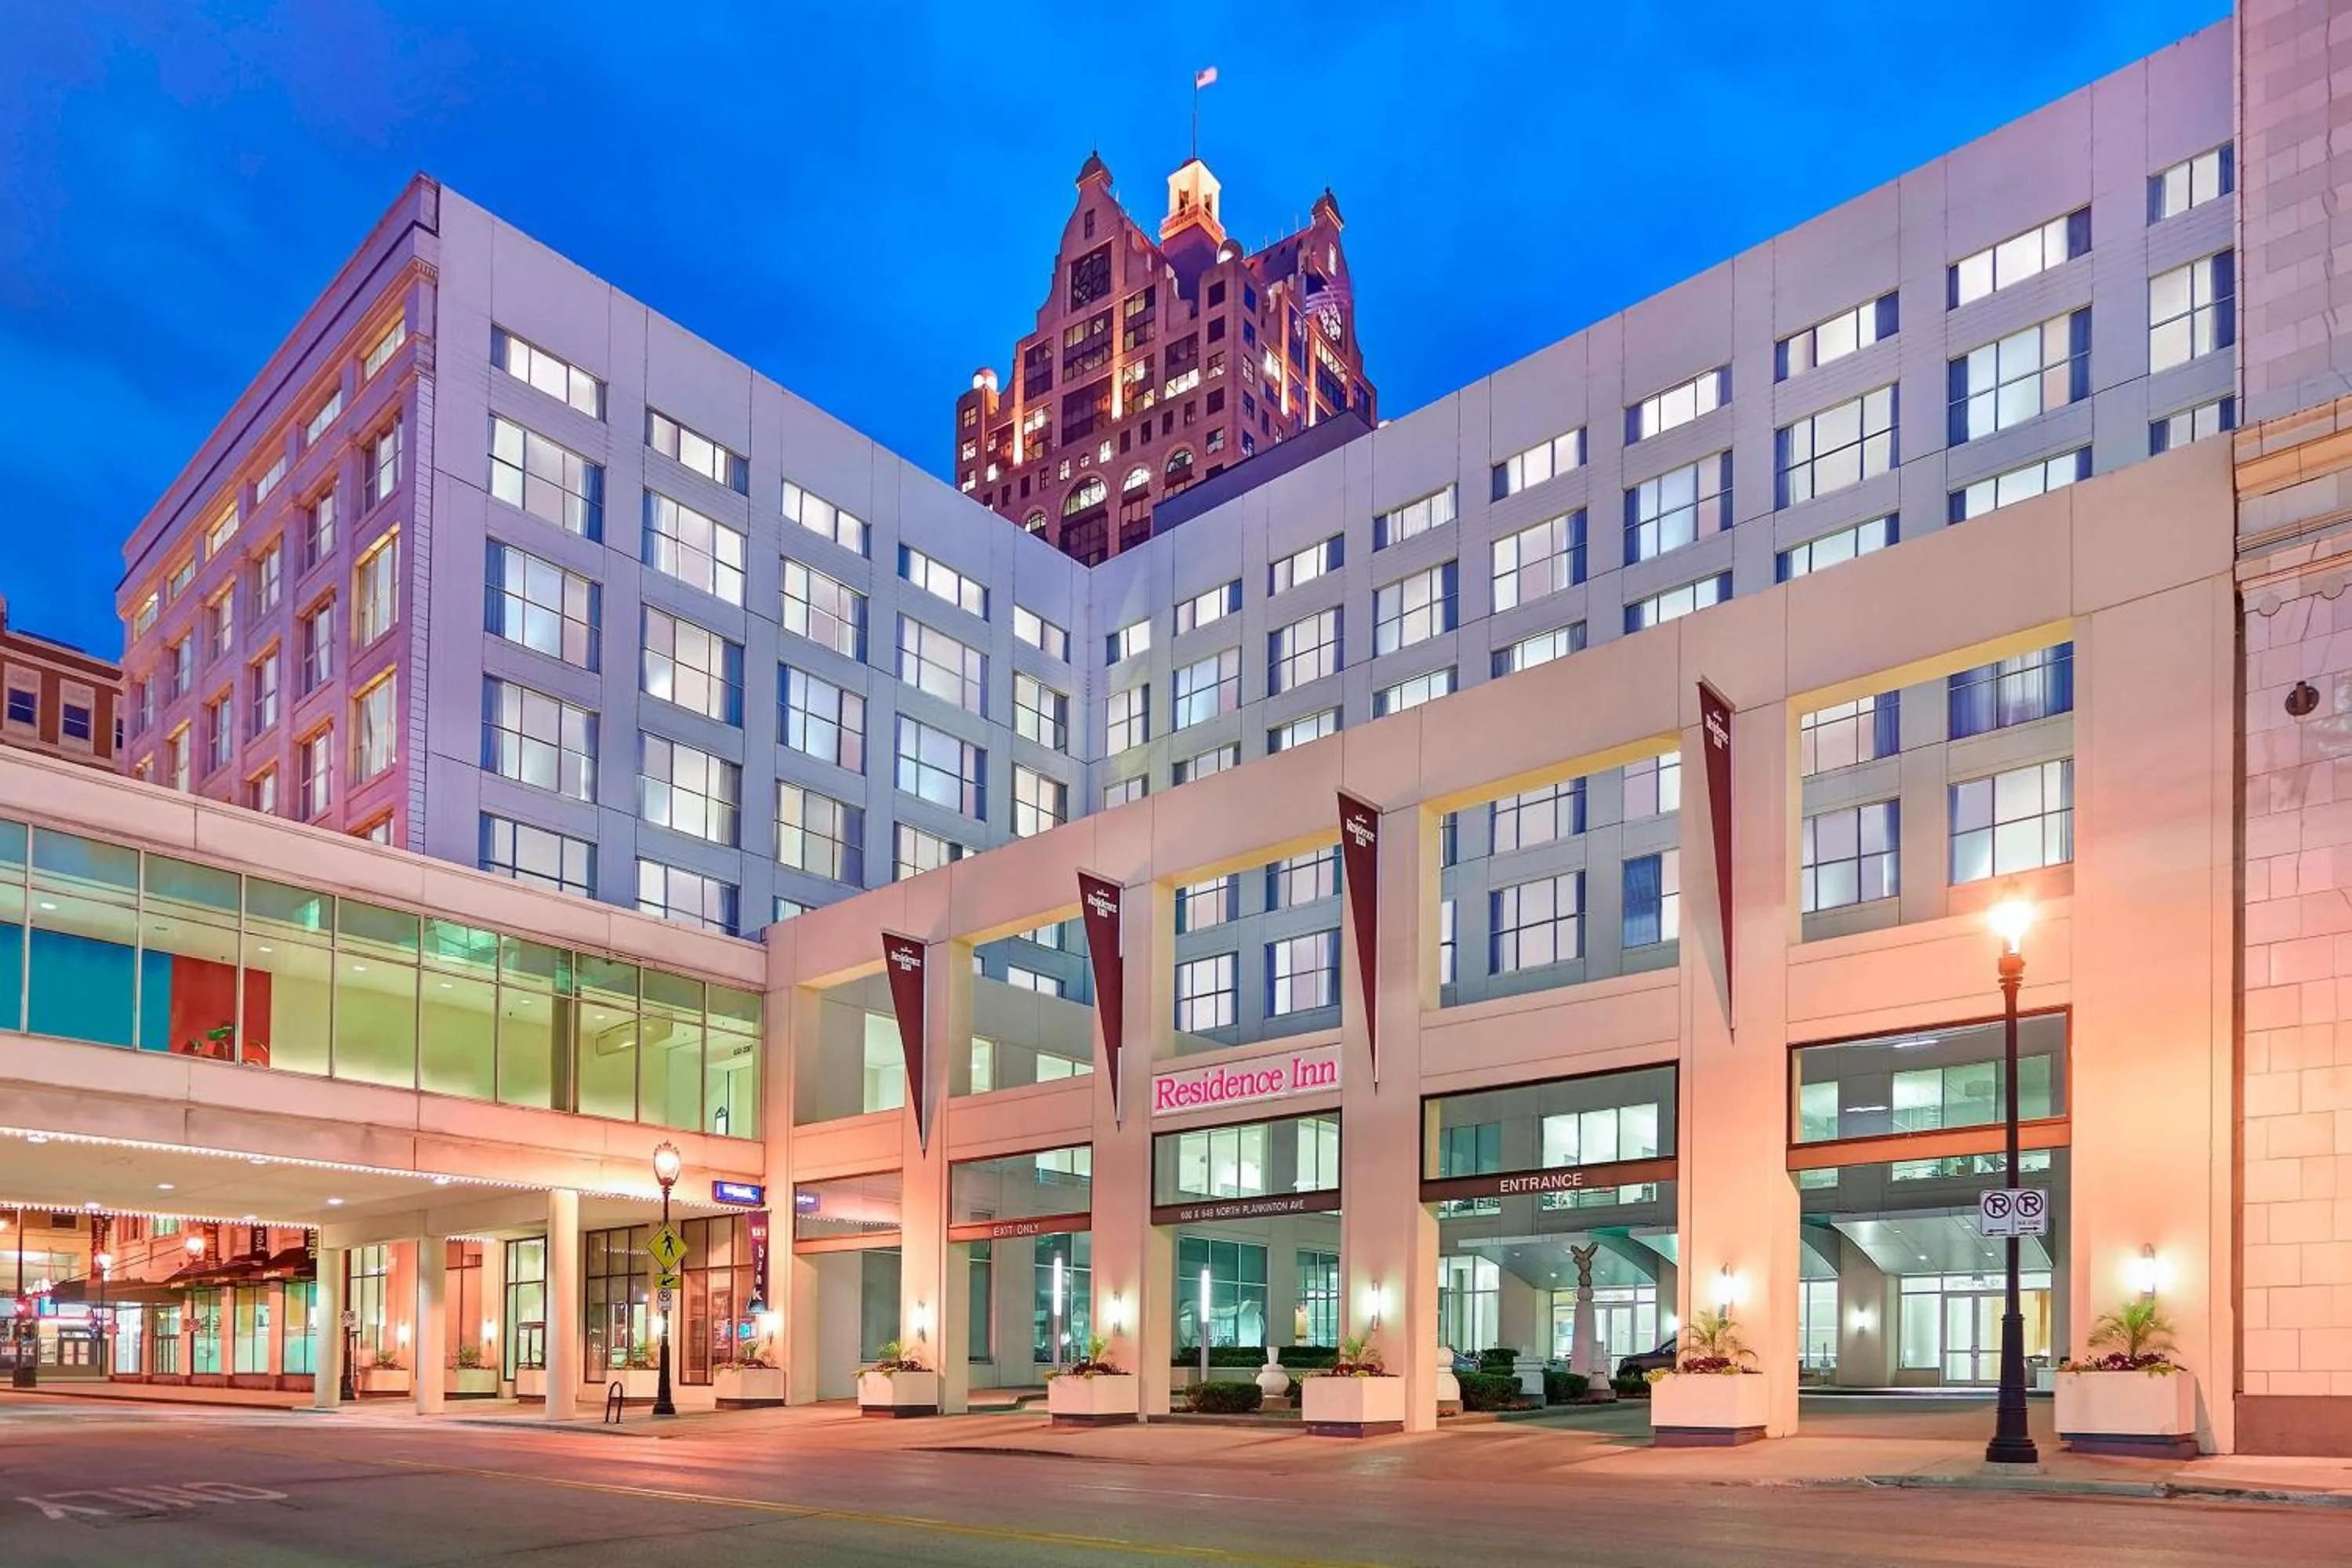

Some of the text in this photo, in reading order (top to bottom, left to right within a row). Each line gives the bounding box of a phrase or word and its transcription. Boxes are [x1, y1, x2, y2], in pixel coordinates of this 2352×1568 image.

[1346, 818, 1375, 843] Residence
[1356, 832, 1367, 848] Inn
[1087, 893, 1117, 913] Residence
[891, 950, 920, 967] Residence
[1156, 1058, 1338, 1109] Residence Inn
[1500, 1173, 1582, 1192] ENTRANCE
[1216, 1206, 1240, 1217] NORTH
[1242, 1201, 1288, 1214] PLANKINTON
[1290, 1199, 1305, 1210] AVE
[993, 1223, 1039, 1236] EXIT ONLY
